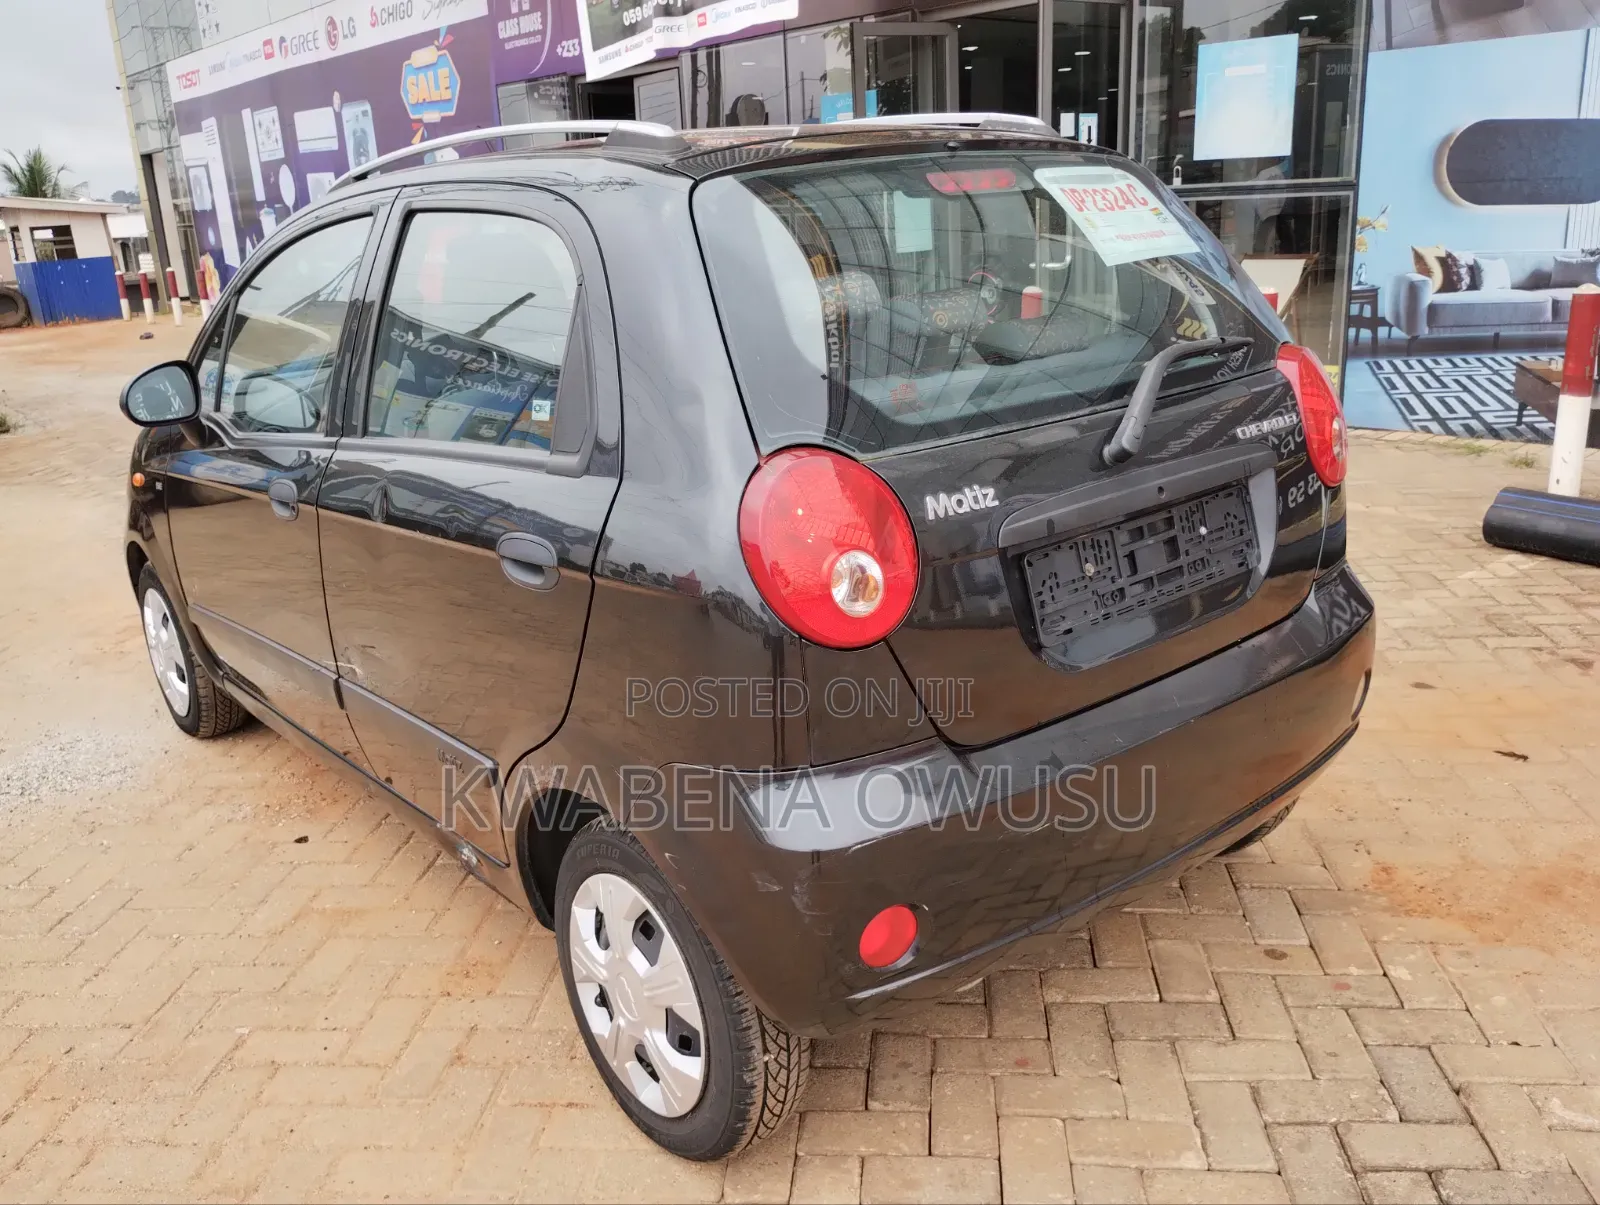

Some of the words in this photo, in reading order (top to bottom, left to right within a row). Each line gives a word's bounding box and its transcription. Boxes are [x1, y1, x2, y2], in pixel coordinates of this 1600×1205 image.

[380, 1, 413, 26] CHIGO
[623, 6, 643, 26] 059
[341, 16, 357, 40] LG
[654, 24, 685, 34] GREE
[290, 29, 320, 56] GREE
[556, 38, 580, 57] +233
[176, 68, 200, 91] TOSOT
[407, 67, 452, 105] SALE
[1236, 412, 1297, 440] CHEVROLET
[925, 484, 1000, 521] Matiz
